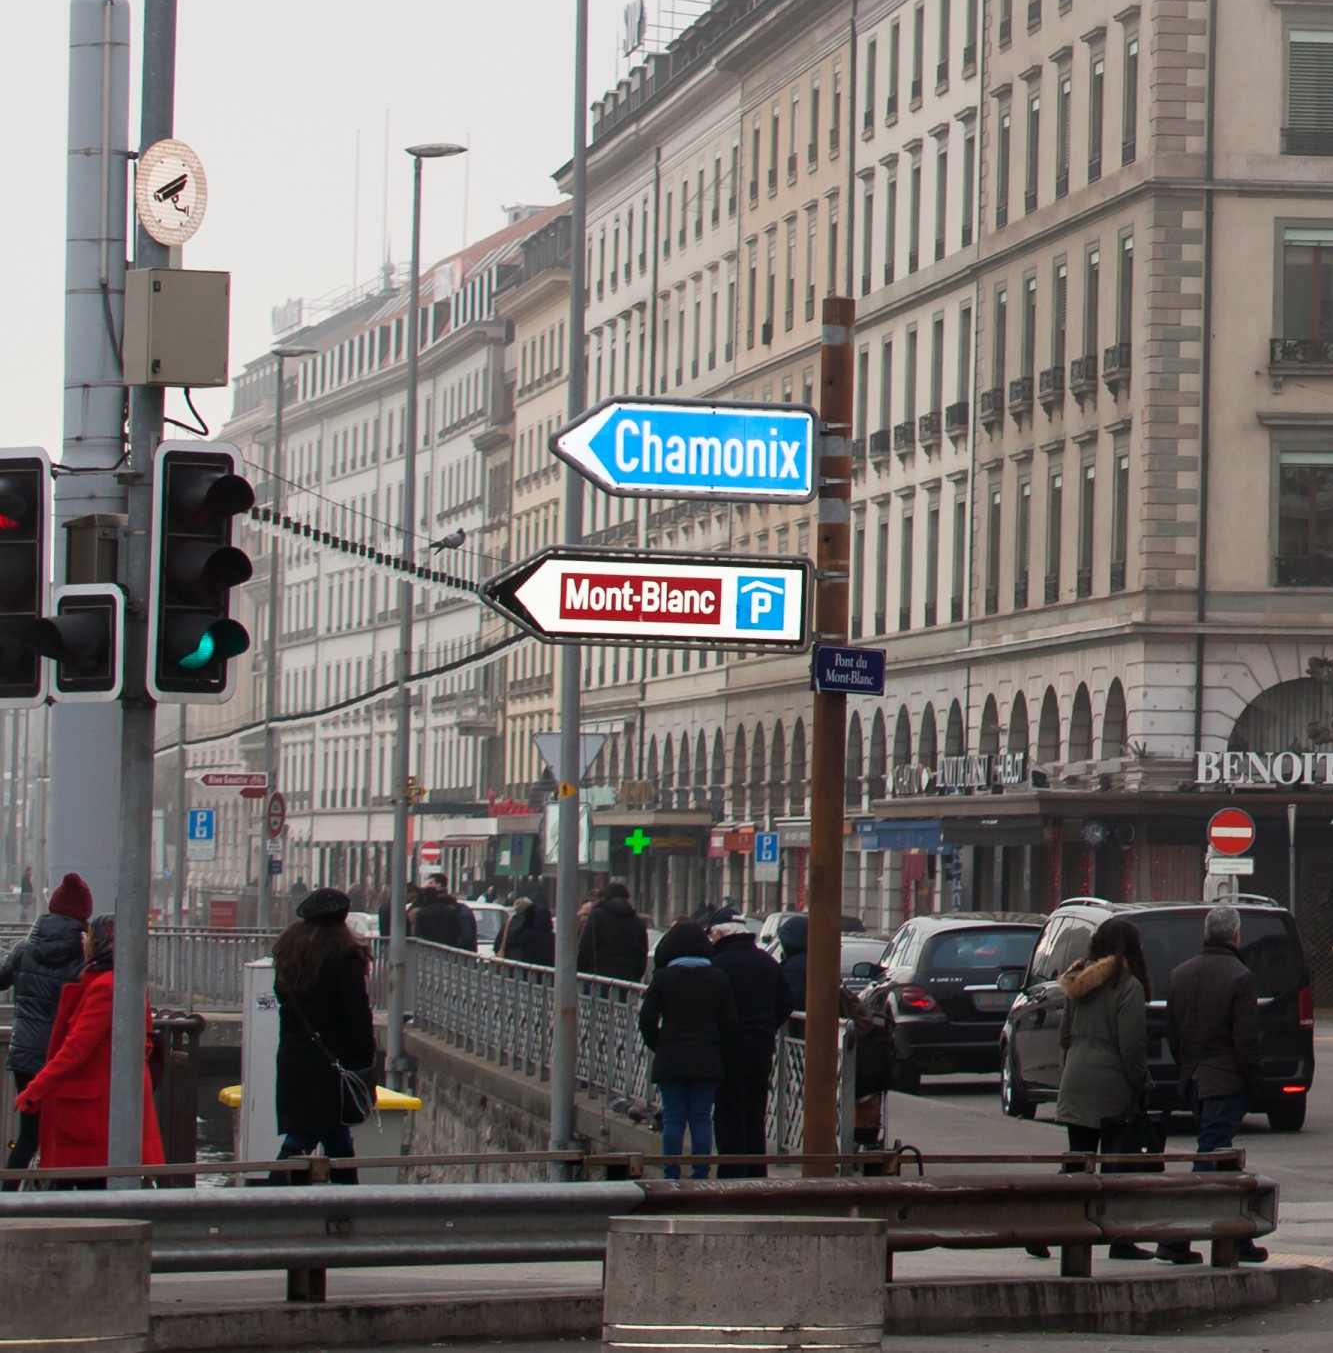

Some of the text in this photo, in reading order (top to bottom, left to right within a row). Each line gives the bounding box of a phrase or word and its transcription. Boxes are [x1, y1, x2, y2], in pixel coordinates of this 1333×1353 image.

[614, 418, 801, 479] Chamonix
[564, 577, 772, 625] Mont-Blanc P
[825, 668, 875, 687] Mont-Blanc
[835, 653, 868, 669] Pont du
